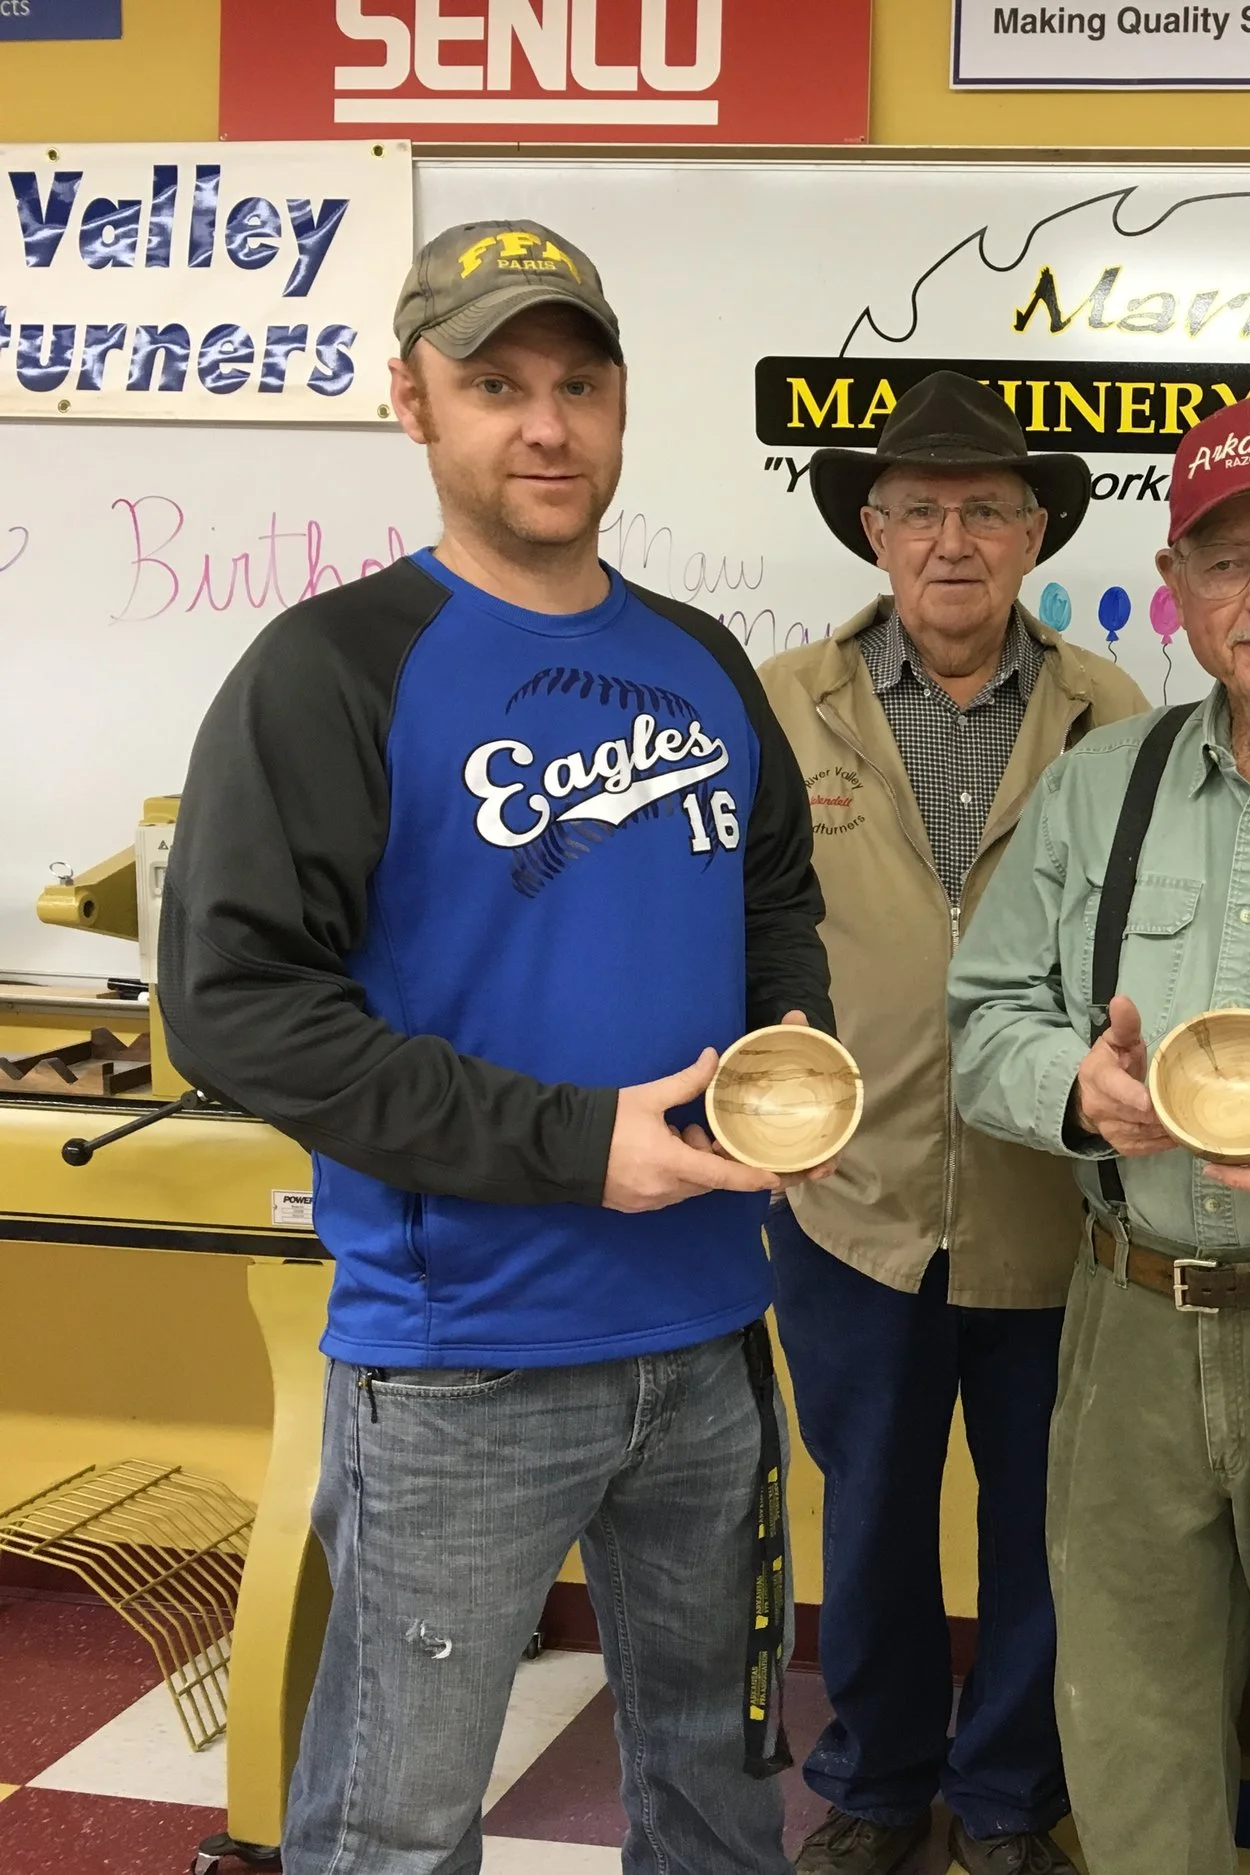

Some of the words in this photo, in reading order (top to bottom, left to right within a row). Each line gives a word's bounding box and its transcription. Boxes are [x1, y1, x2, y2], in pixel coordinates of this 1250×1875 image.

[993, 7, 1106, 41] Making
[1117, 6, 1230, 40] Quality
[8, 164, 350, 297] Valley
[458, 231, 582, 285] FFA
[497, 259, 557, 270] PARIS
[463, 713, 729, 848] Eagles
[804, 769, 831, 789] River
[834, 766, 863, 790] Valley
[682, 790, 740, 854] 16
[812, 815, 866, 835] dturners
